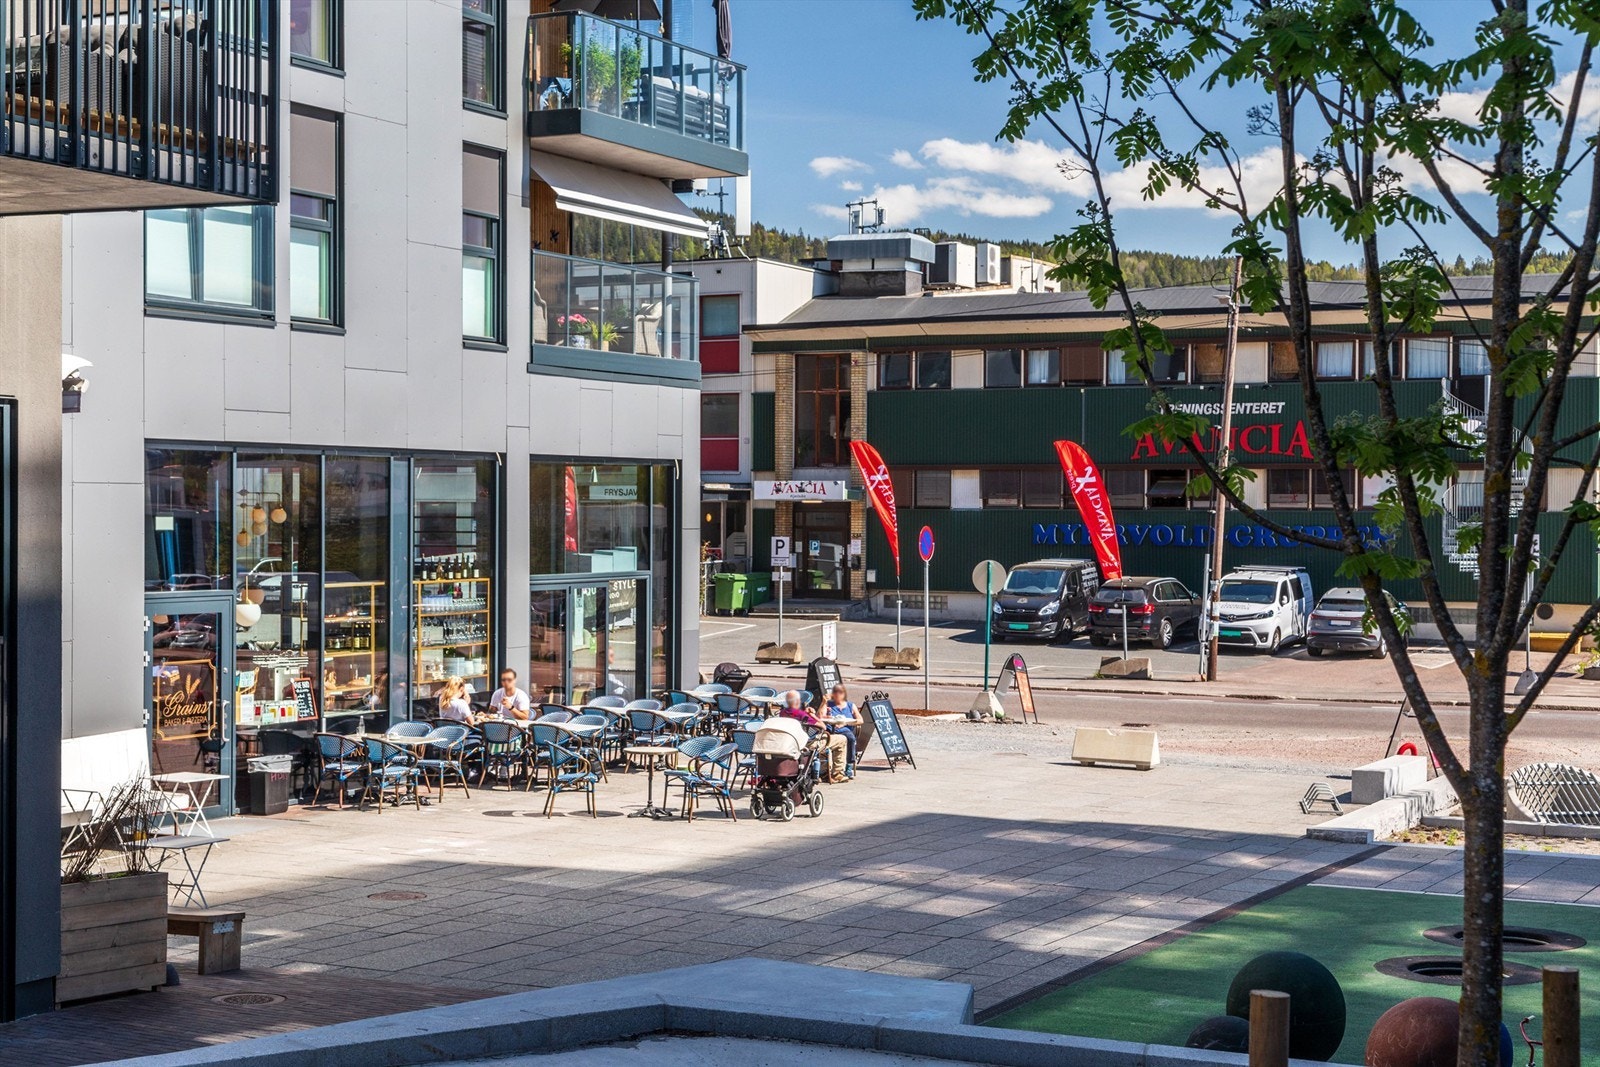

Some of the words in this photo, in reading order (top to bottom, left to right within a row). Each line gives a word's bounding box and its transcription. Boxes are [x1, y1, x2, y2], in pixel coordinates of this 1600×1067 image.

[775, 540, 785, 555] P
[613, 578, 636, 591] STYLE
[163, 690, 210, 718] Grains
